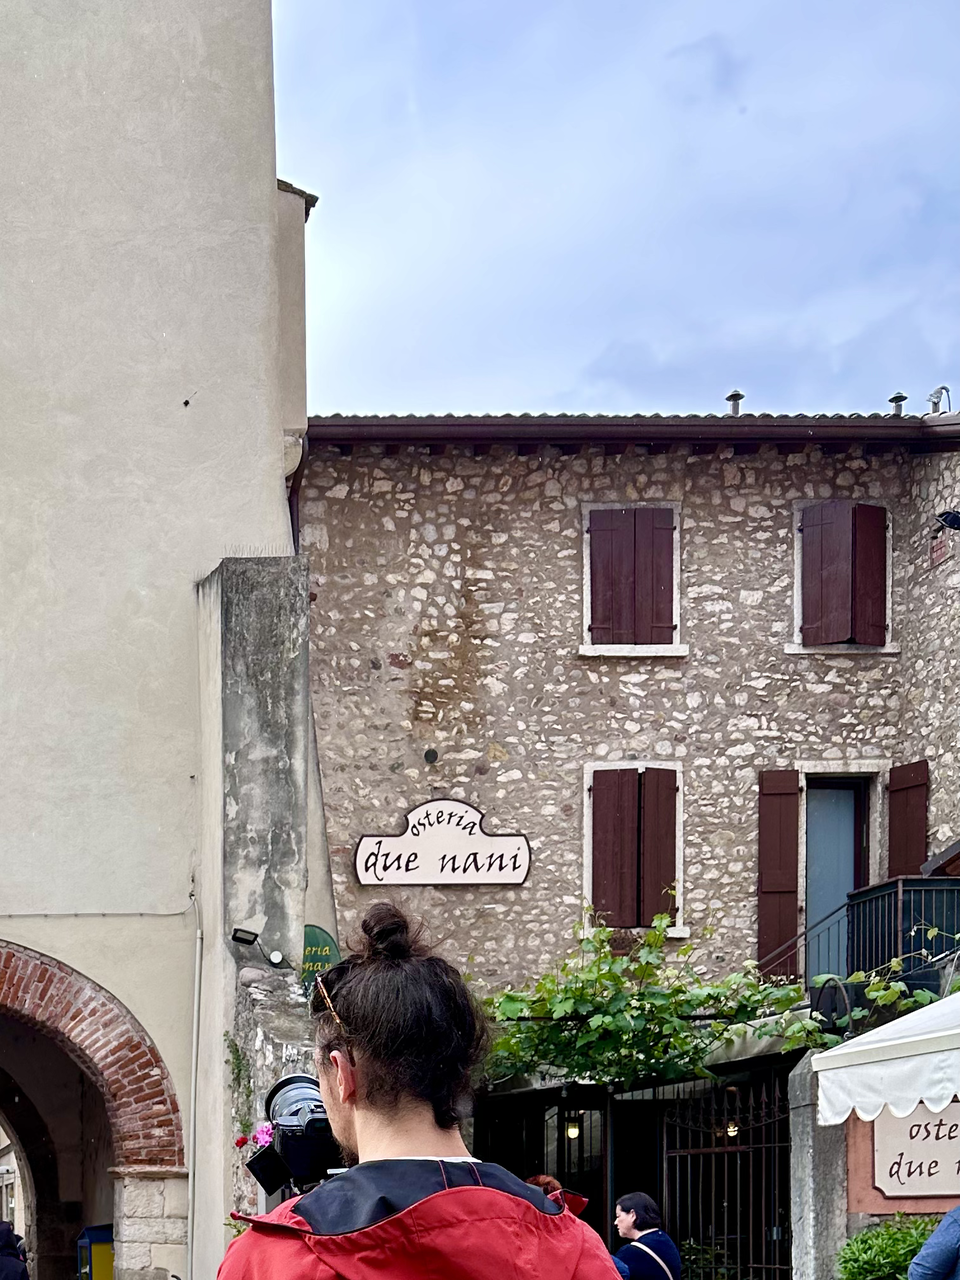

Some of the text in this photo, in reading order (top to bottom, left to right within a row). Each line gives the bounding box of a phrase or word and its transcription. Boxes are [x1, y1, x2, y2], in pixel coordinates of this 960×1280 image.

[410, 810, 478, 837] osteria
[364, 840, 522, 881] due nani
[304, 945, 331, 956] eria
[909, 1118, 959, 1141] oste
[889, 1152, 940, 1185] due
